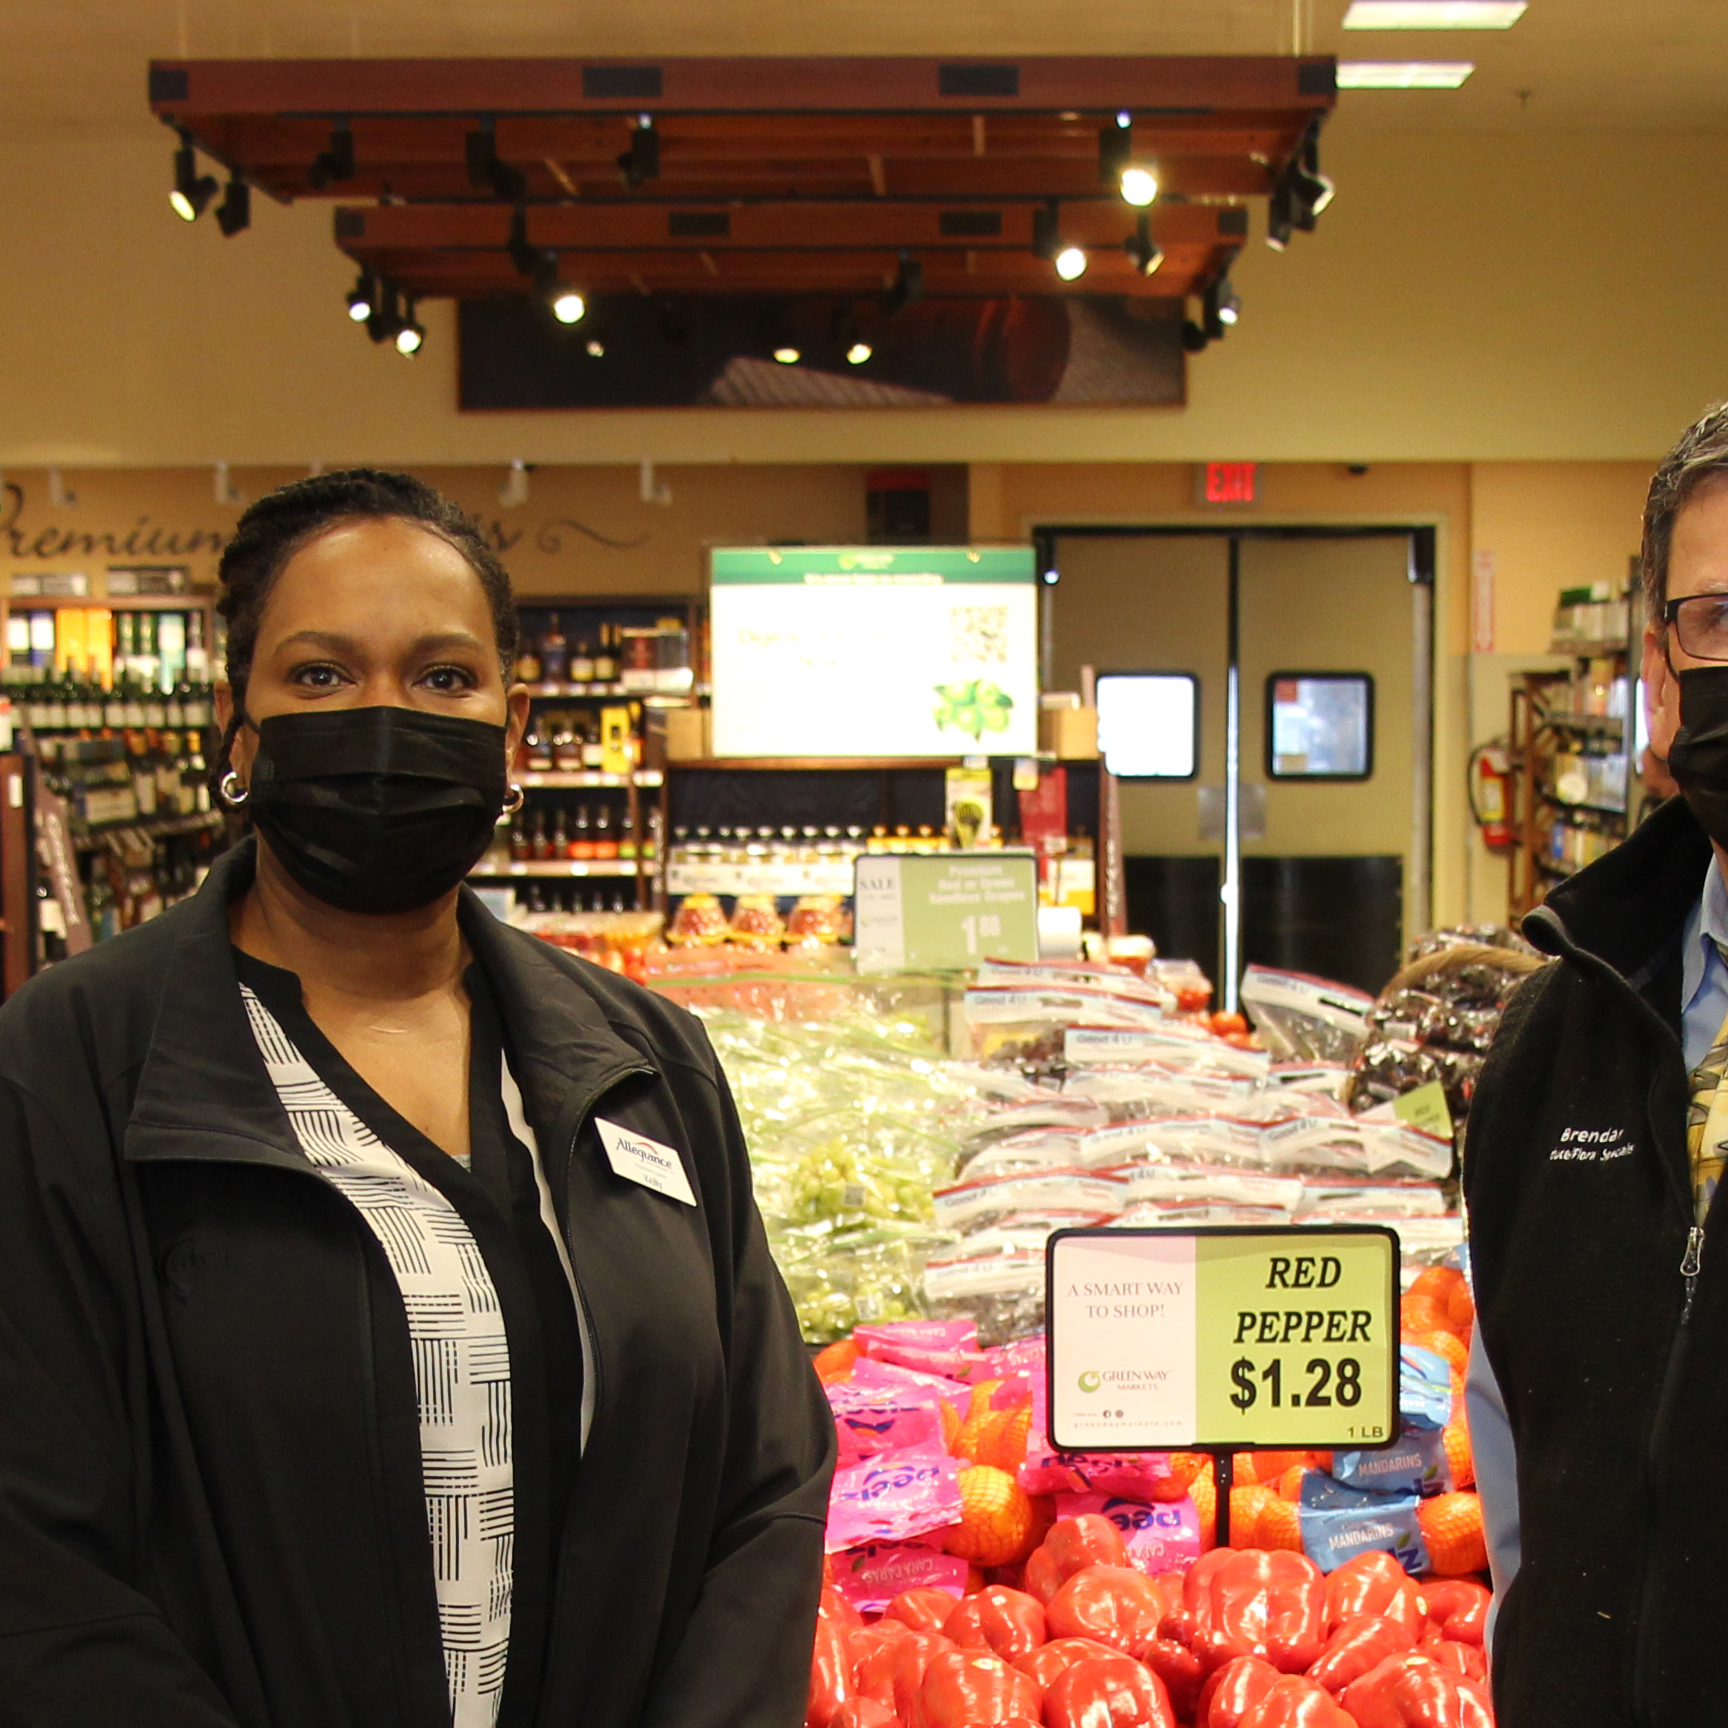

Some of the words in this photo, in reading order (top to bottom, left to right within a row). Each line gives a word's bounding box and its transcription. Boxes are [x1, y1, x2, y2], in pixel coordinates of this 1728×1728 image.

[1206, 462, 1256, 502] EXIT
[616, 1137, 673, 1168] Allegiance
[1266, 1256, 1342, 1289] RED
[1067, 1284, 1080, 1297] A
[1083, 1282, 1142, 1297] SMART
[1146, 1281, 1184, 1296] WAY
[1085, 1304, 1110, 1318] TO
[1113, 1303, 1165, 1318] SHOP!
[1233, 1310, 1372, 1344] PEPPER
[1102, 1370, 1141, 1381] GREEN
[1143, 1370, 1168, 1381] WAY
[1116, 1383, 1159, 1391] MARKETS
[1229, 1356, 1363, 1415] $1.28
[1347, 1427, 1355, 1438] 1
[1362, 1426, 1384, 1438] LB
[1358, 1454, 1423, 1476] MANDARINS
[1328, 1523, 1395, 1550] MANDARINS
